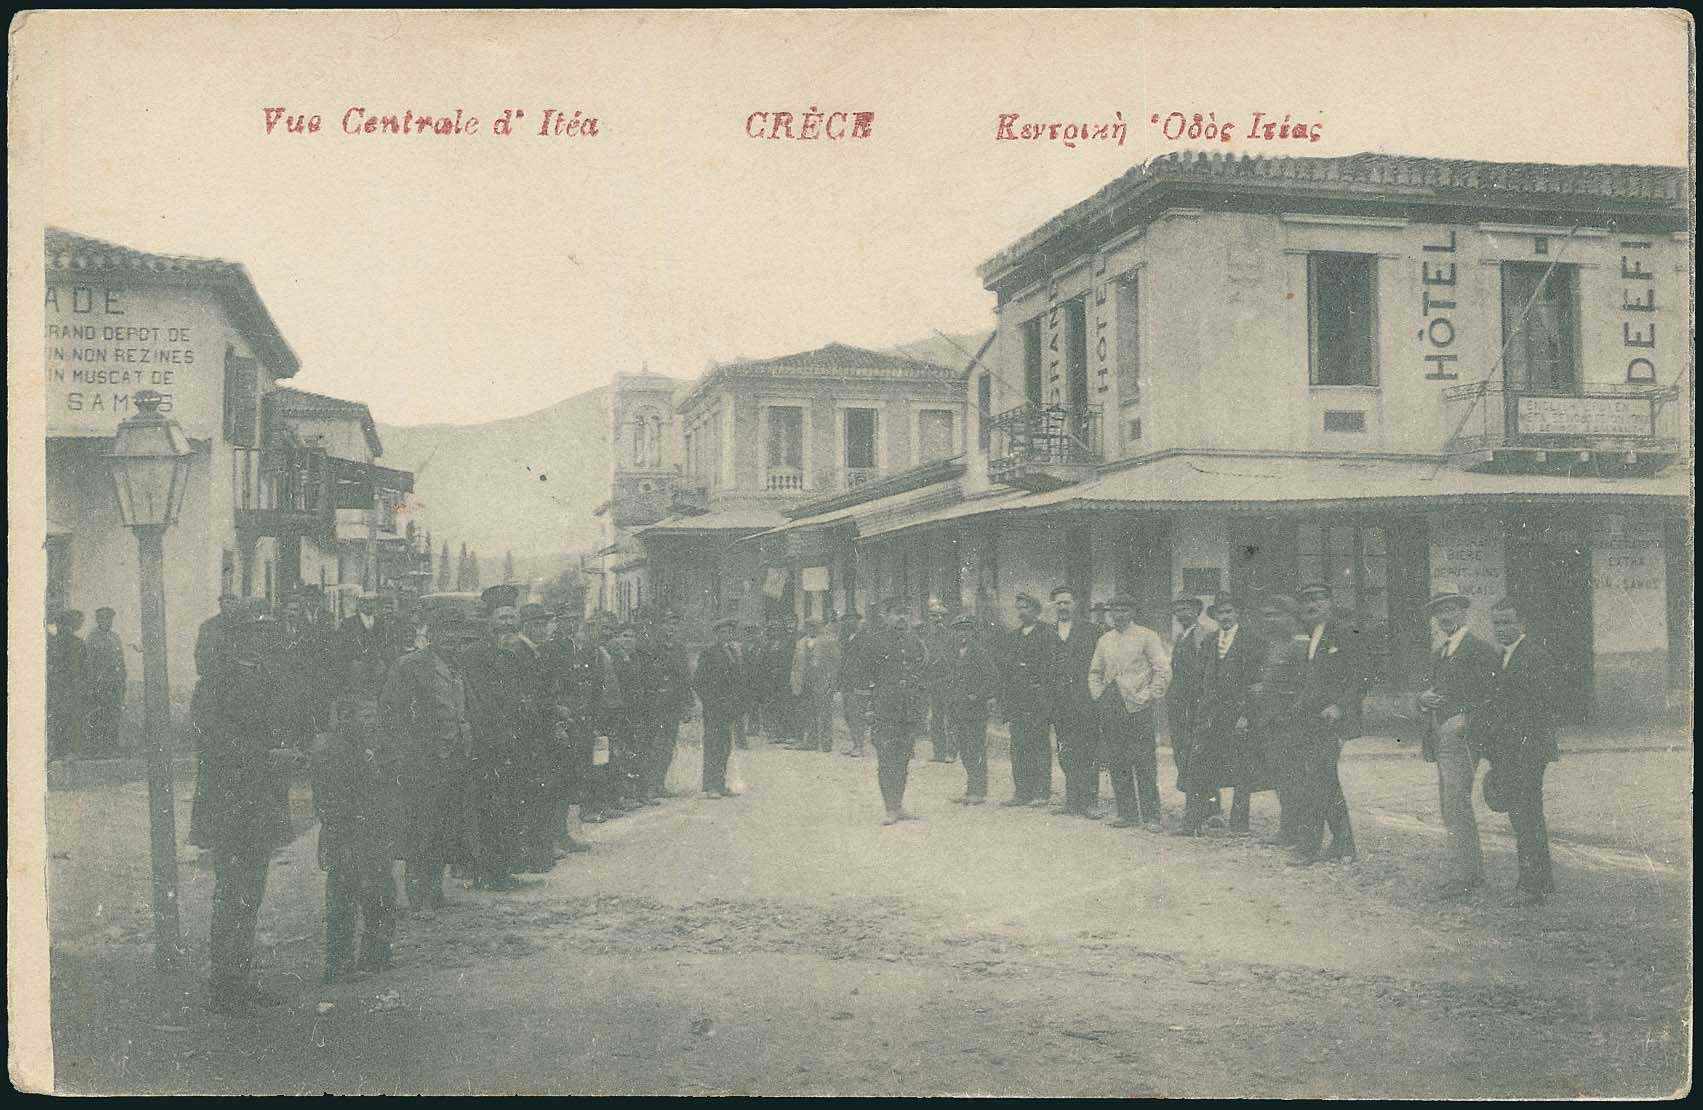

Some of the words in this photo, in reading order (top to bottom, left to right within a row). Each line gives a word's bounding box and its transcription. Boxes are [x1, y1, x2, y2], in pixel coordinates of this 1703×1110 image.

[1417, 230, 1458, 381] HÔTEL
[103, 325, 161, 342] DEPOT
[168, 327, 191, 343] DE
[45, 347, 64, 361] IN
[72, 347, 106, 363] NON
[114, 349, 194, 365] REZINES
[47, 368, 64, 383] IN
[72, 369, 143, 385] MUSCAT
[151, 370, 174, 385] DE
[67, 391, 174, 412] SAMS
